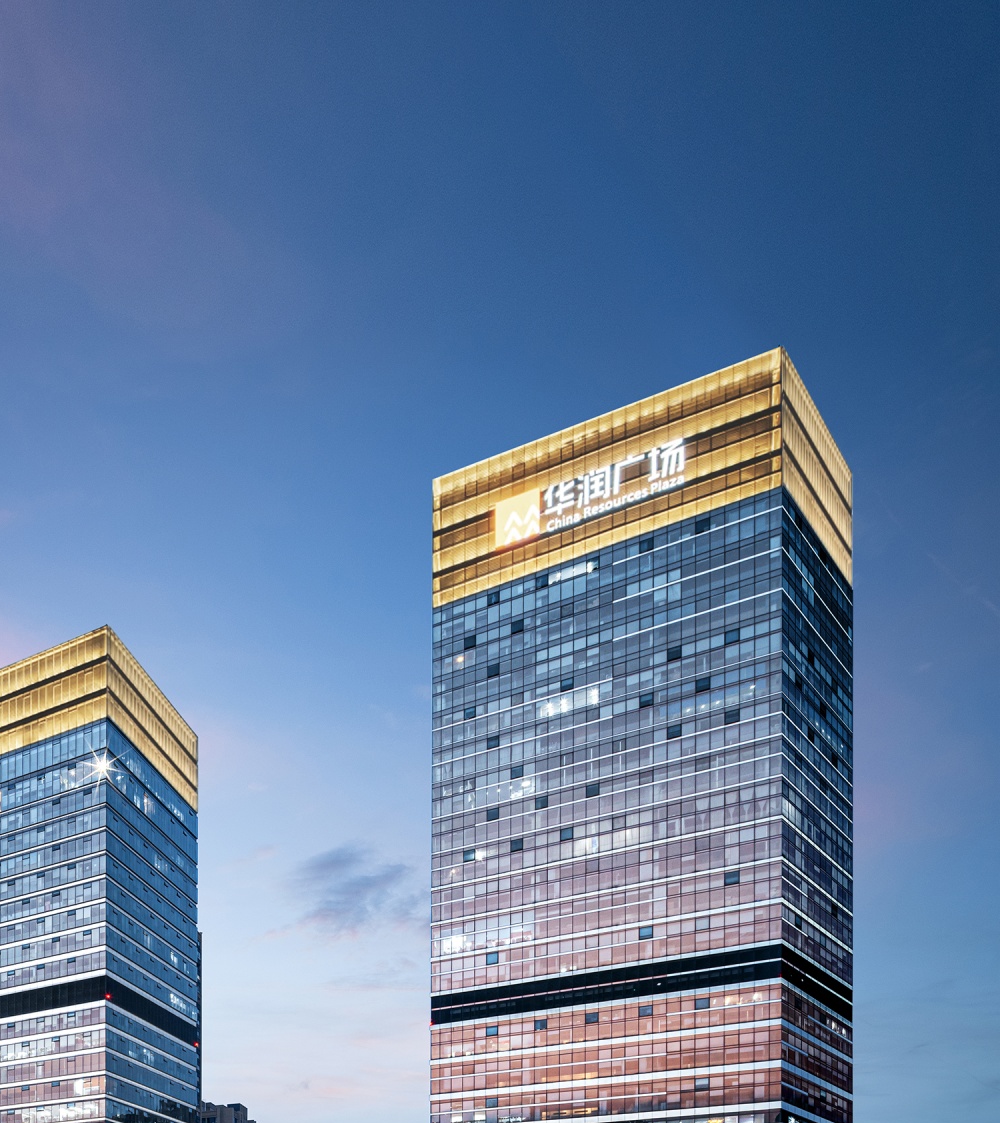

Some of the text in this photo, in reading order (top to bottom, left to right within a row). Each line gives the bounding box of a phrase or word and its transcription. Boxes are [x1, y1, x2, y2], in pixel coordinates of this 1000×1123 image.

[544, 437, 686, 516] 华润广场
[547, 474, 686, 532] China Resources Plaza
